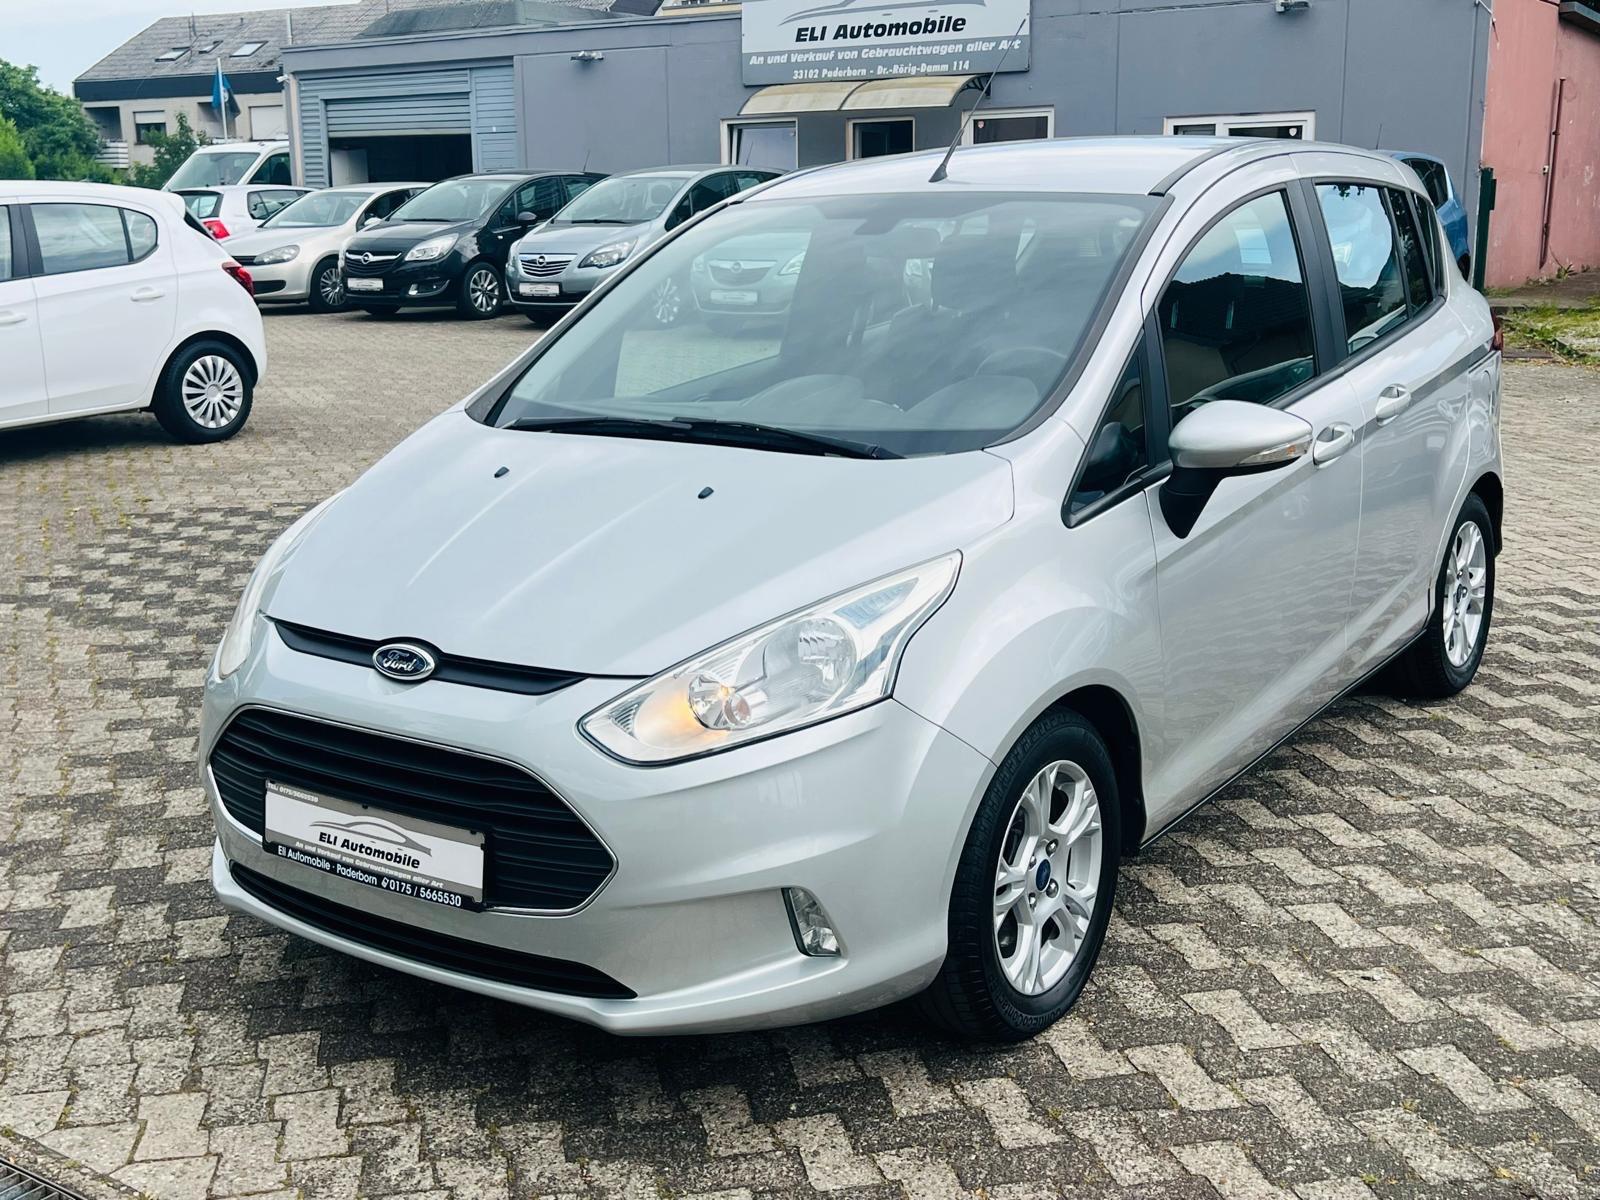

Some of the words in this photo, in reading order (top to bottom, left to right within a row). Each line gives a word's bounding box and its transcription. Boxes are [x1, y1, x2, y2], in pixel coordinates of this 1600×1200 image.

[795, 26, 827, 42] ELI
[833, 16, 966, 40] Automobile
[749, 55, 764, 65] An
[767, 53, 788, 64] und
[790, 50, 835, 63] Verkauf
[837, 50, 858, 60] von
[861, 44, 963, 58] Gebrauchtwagen
[966, 40, 996, 52] aller
[793, 69, 819, 79] 33102
[821, 66, 867, 78] Paderborn
[877, 62, 949, 75] Dr.-Rörig-Damm
[953, 60, 970, 71] 114
[382, 650, 417, 671] Ford
[318, 831, 338, 845] ELI
[340, 839, 420, 868] Automobile
[277, 845, 287, 856] Eli
[287, 849, 331, 871] Automobile
[336, 863, 378, 886] Paderborn
[389, 879, 412, 894] 0175
[419, 887, 462, 907] 5665530
[430, 880, 444, 888] Art
